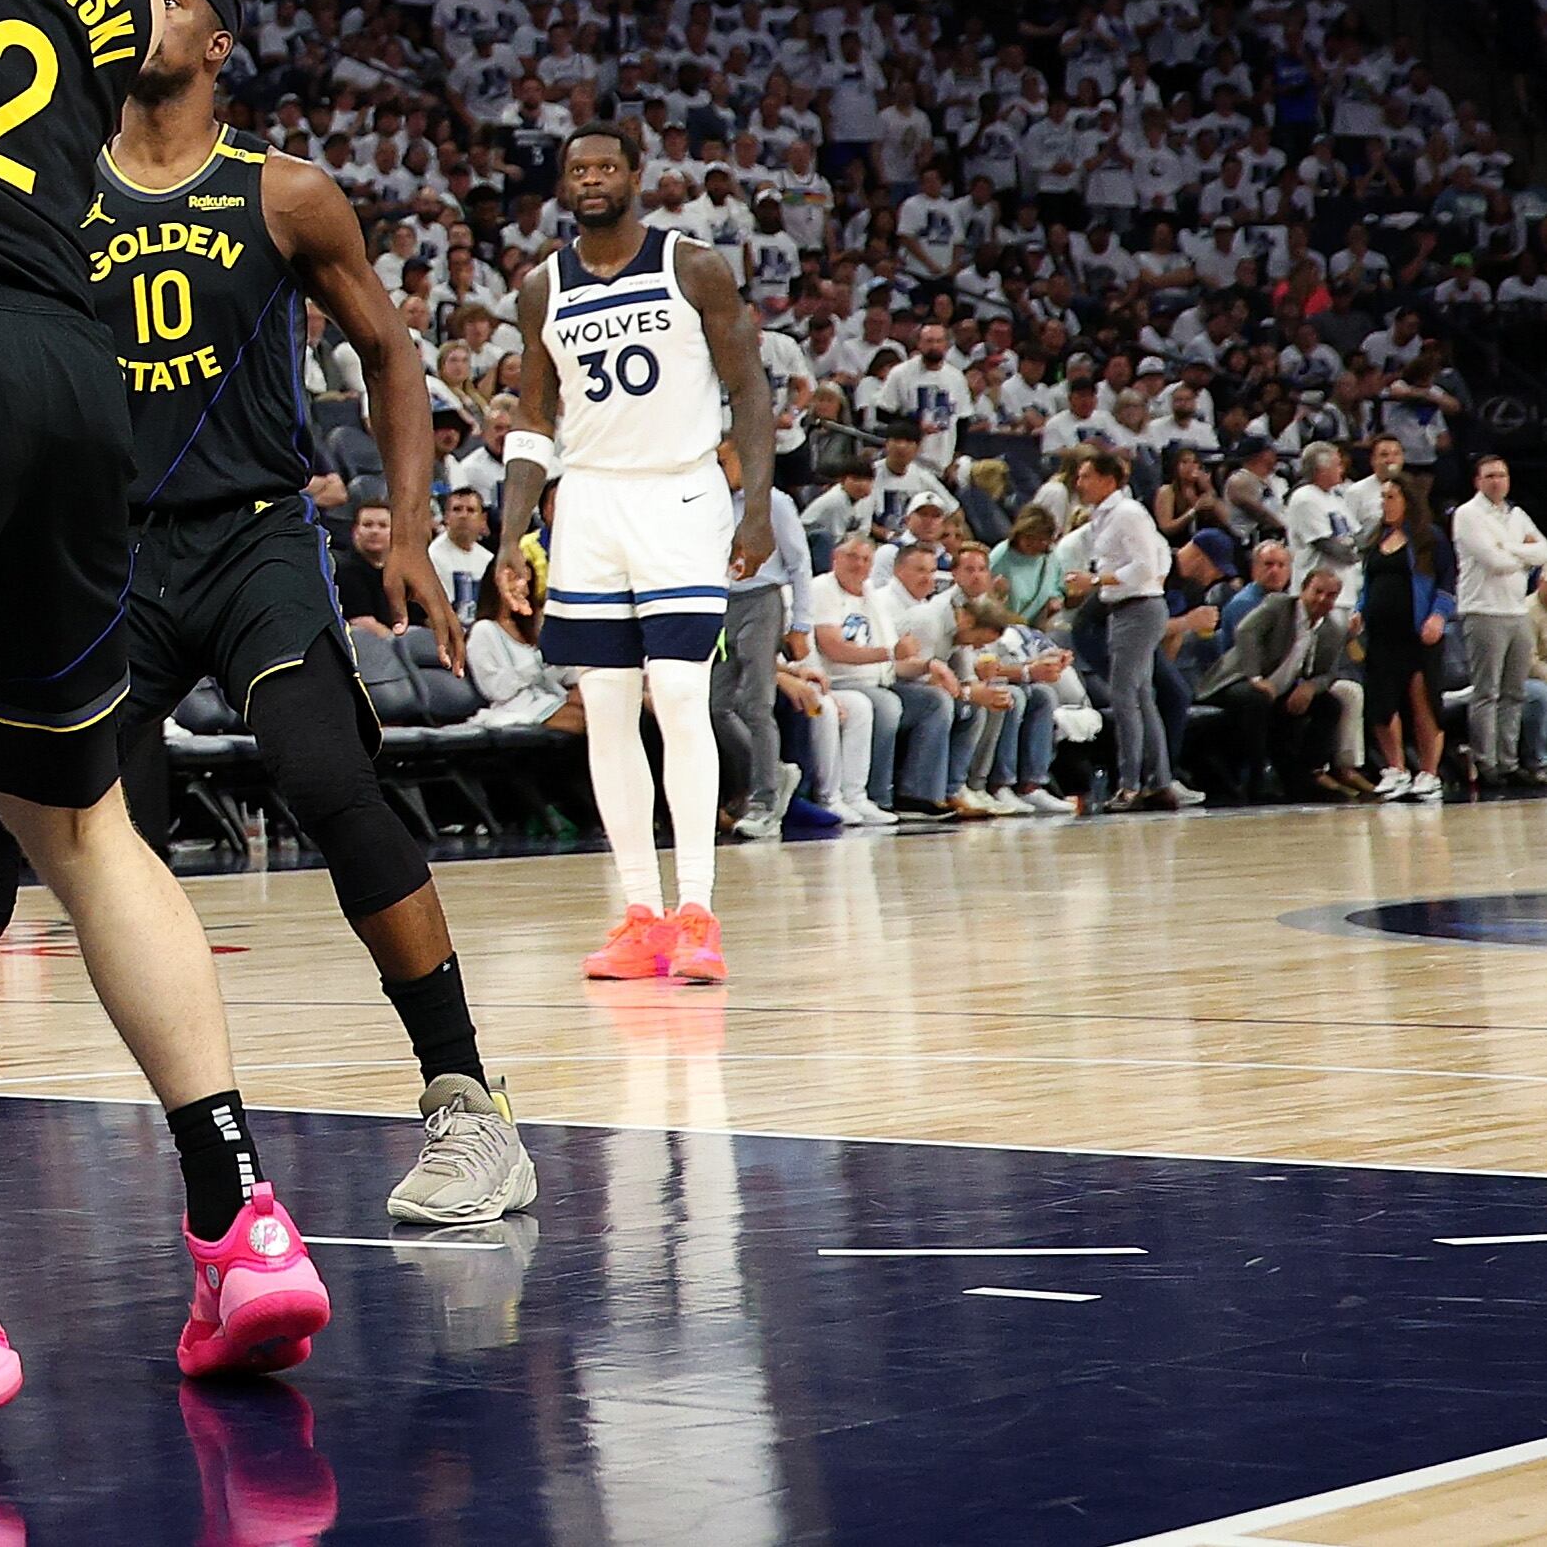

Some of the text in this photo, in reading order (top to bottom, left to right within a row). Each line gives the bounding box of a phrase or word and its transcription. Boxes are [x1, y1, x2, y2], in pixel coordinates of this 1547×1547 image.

[188, 194, 245, 209] Rakuten
[89, 222, 245, 283] GOLDEN
[132, 269, 193, 344] 10
[557, 309, 672, 349] WOLVES
[576, 344, 661, 403] 30
